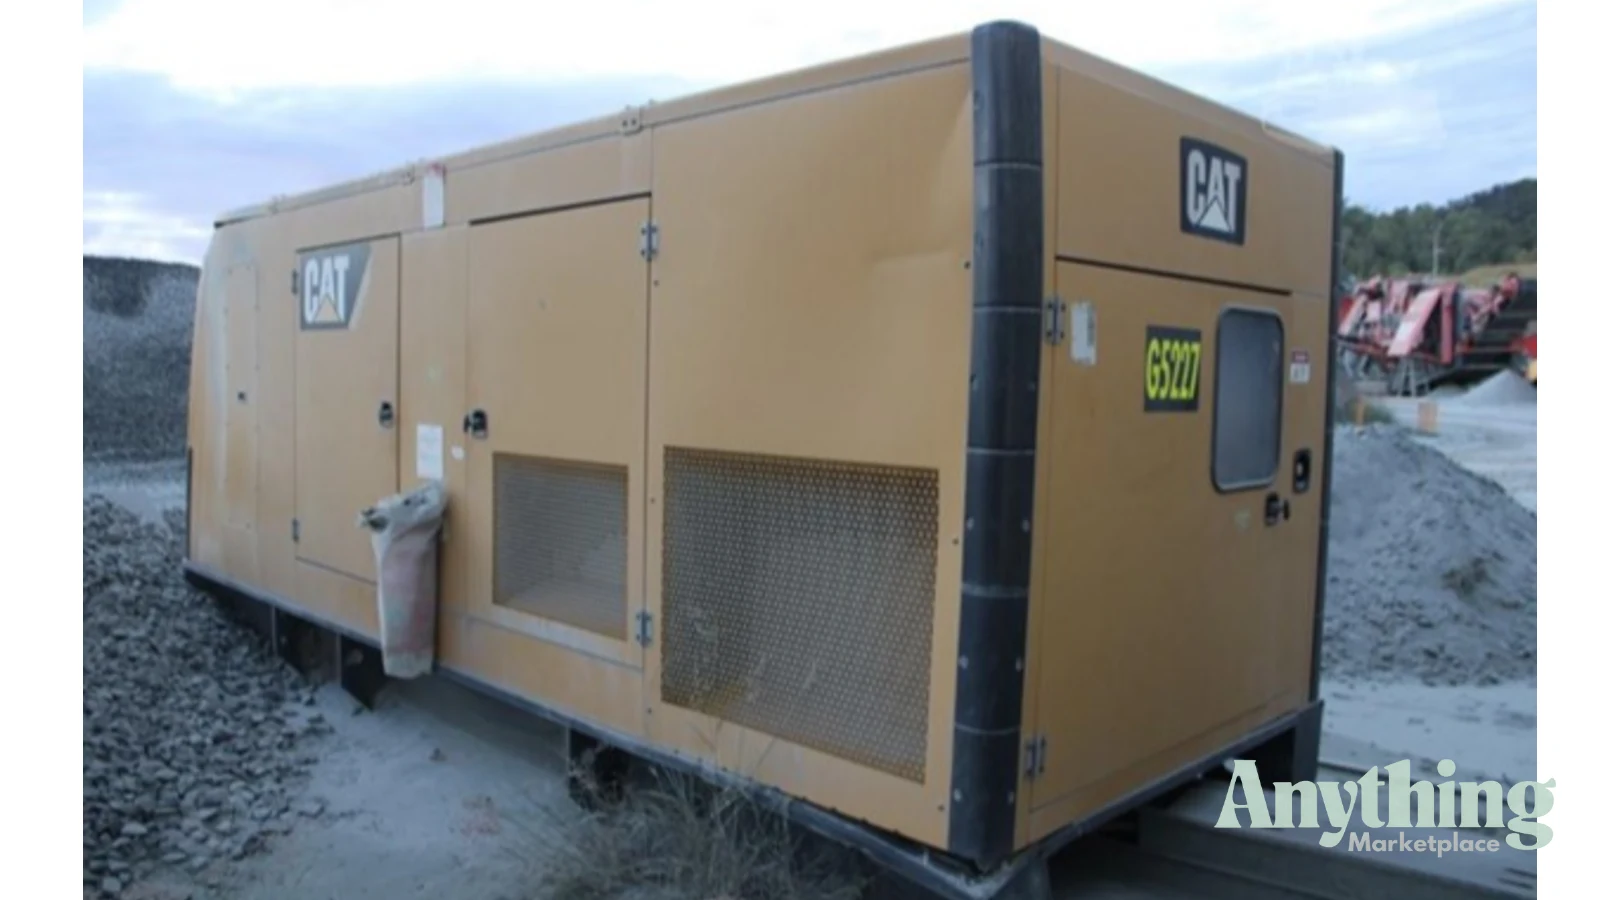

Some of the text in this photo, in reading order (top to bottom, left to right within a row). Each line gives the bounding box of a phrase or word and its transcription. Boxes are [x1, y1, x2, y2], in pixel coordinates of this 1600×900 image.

[1186, 149, 1240, 233] CAT
[304, 254, 349, 323] CAT
[1146, 338, 1200, 398] G5227
